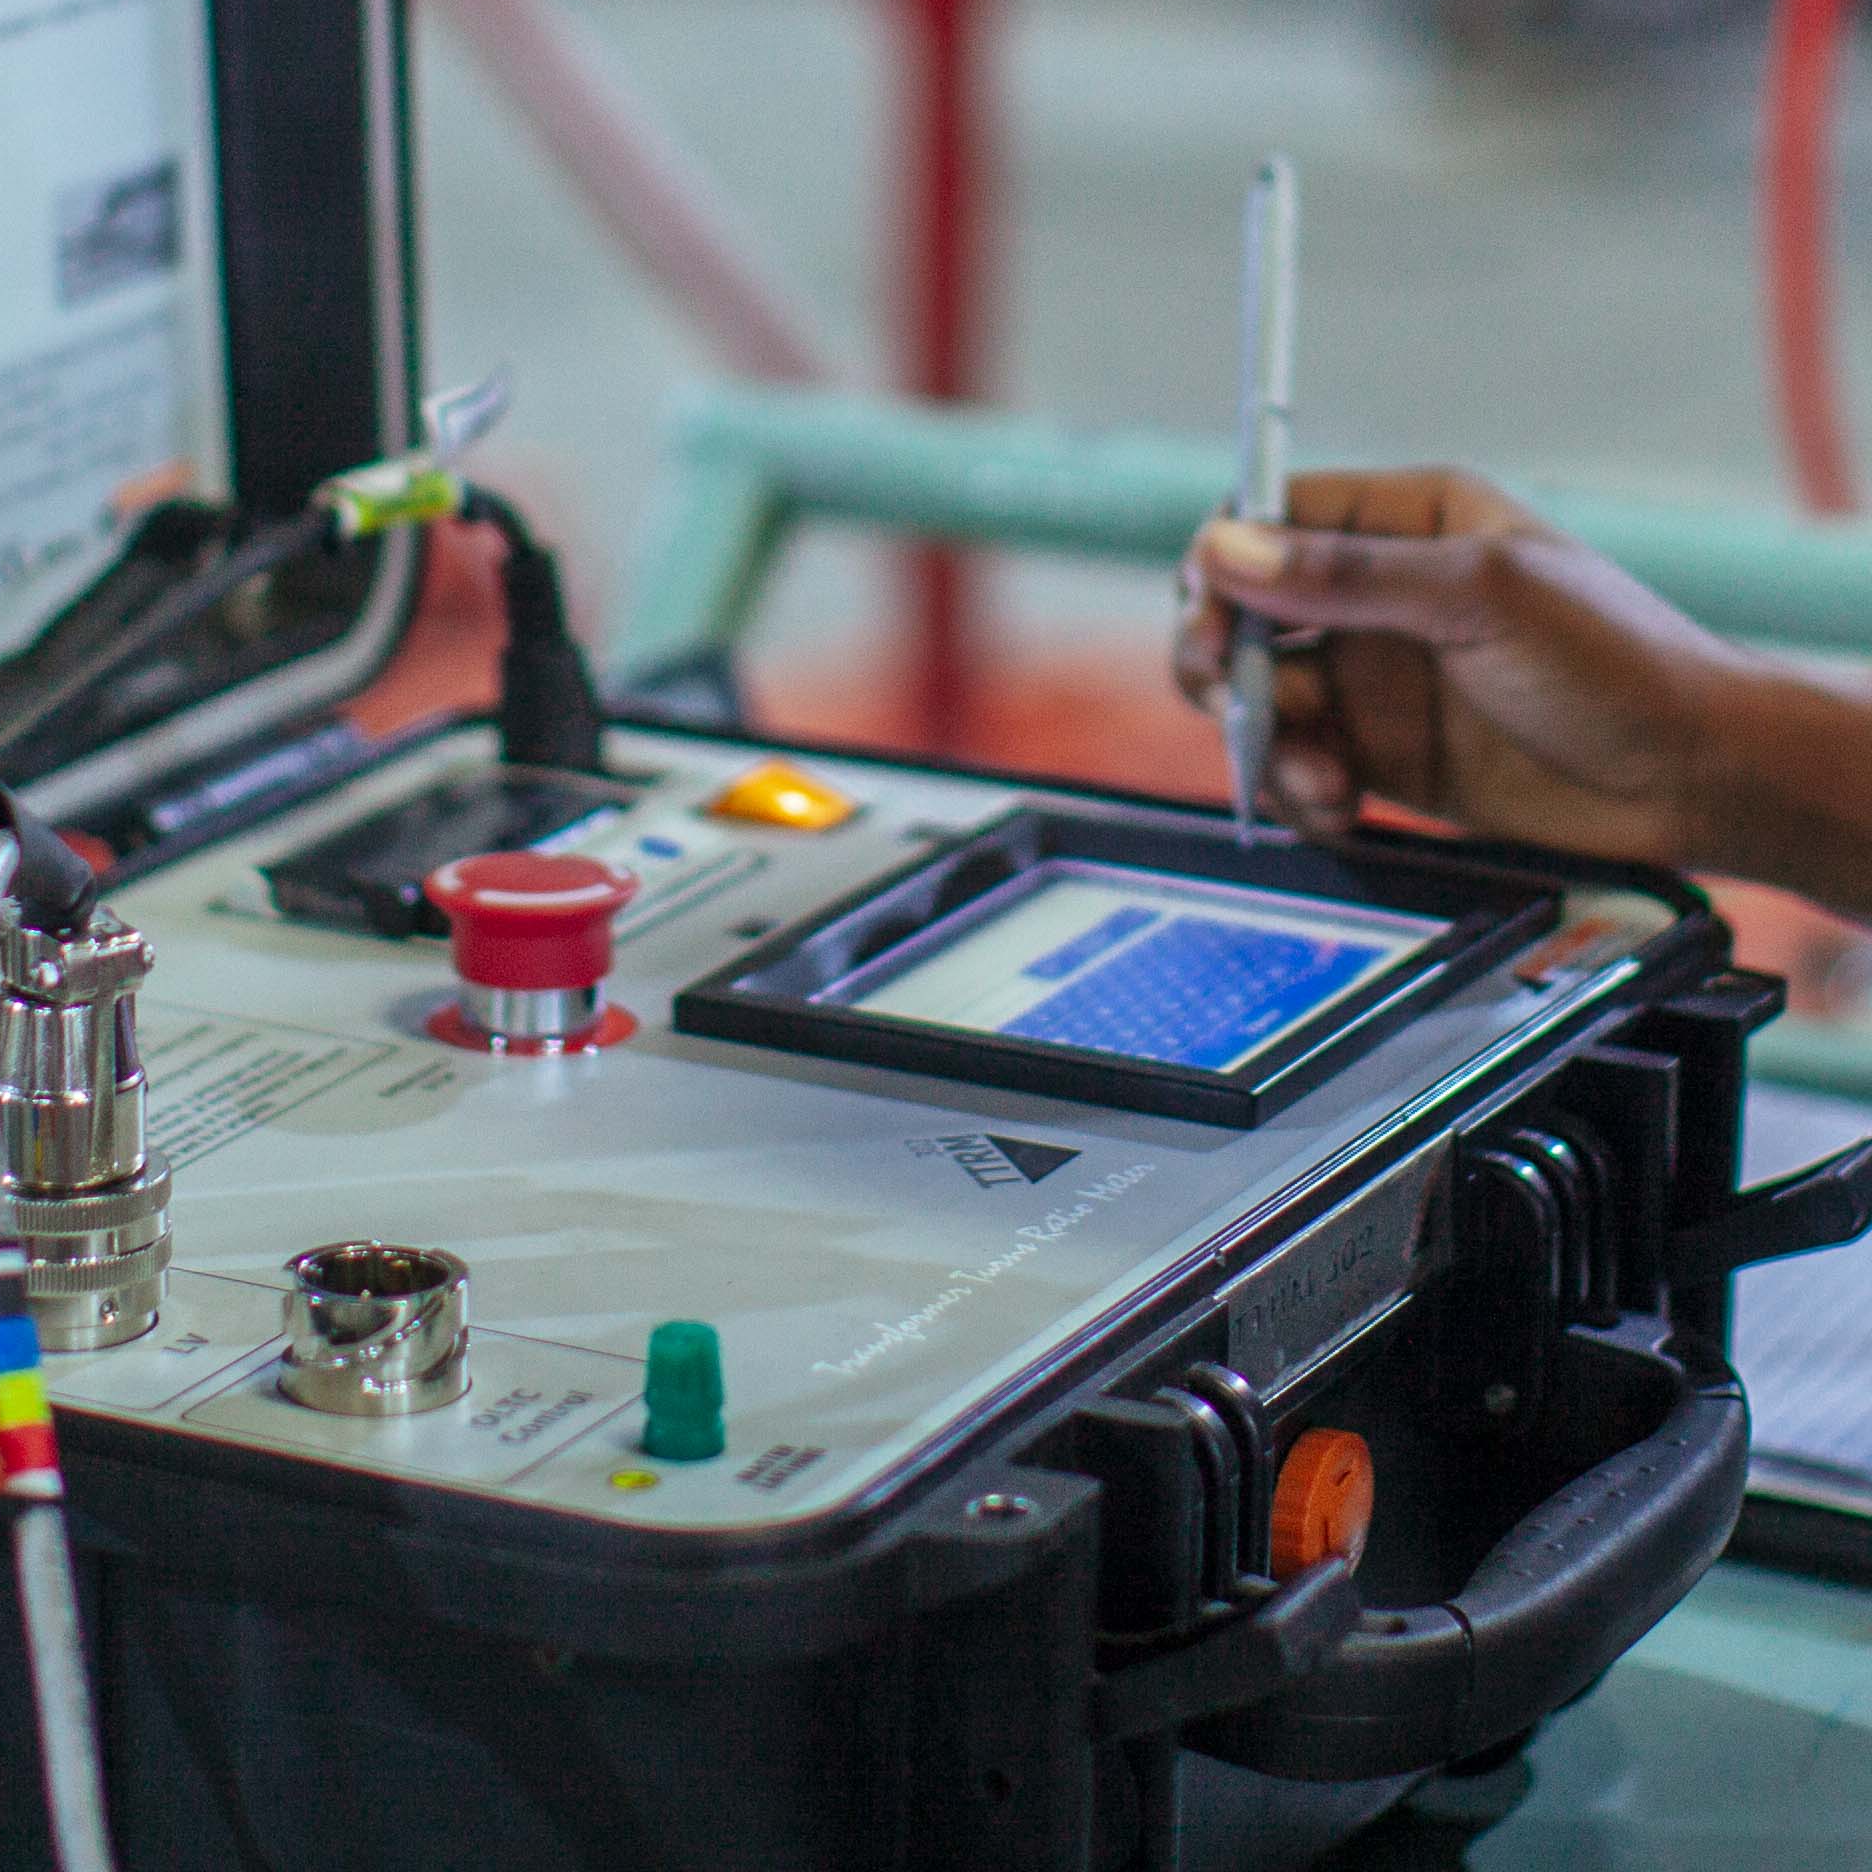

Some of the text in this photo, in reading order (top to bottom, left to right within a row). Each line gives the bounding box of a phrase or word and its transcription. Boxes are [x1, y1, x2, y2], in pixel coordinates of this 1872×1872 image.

[1014, 1201, 1094, 1244] Ratio
[163, 1331, 210, 1354] LV
[470, 1388, 543, 1427] OLTC
[498, 1390, 594, 1443] Control
